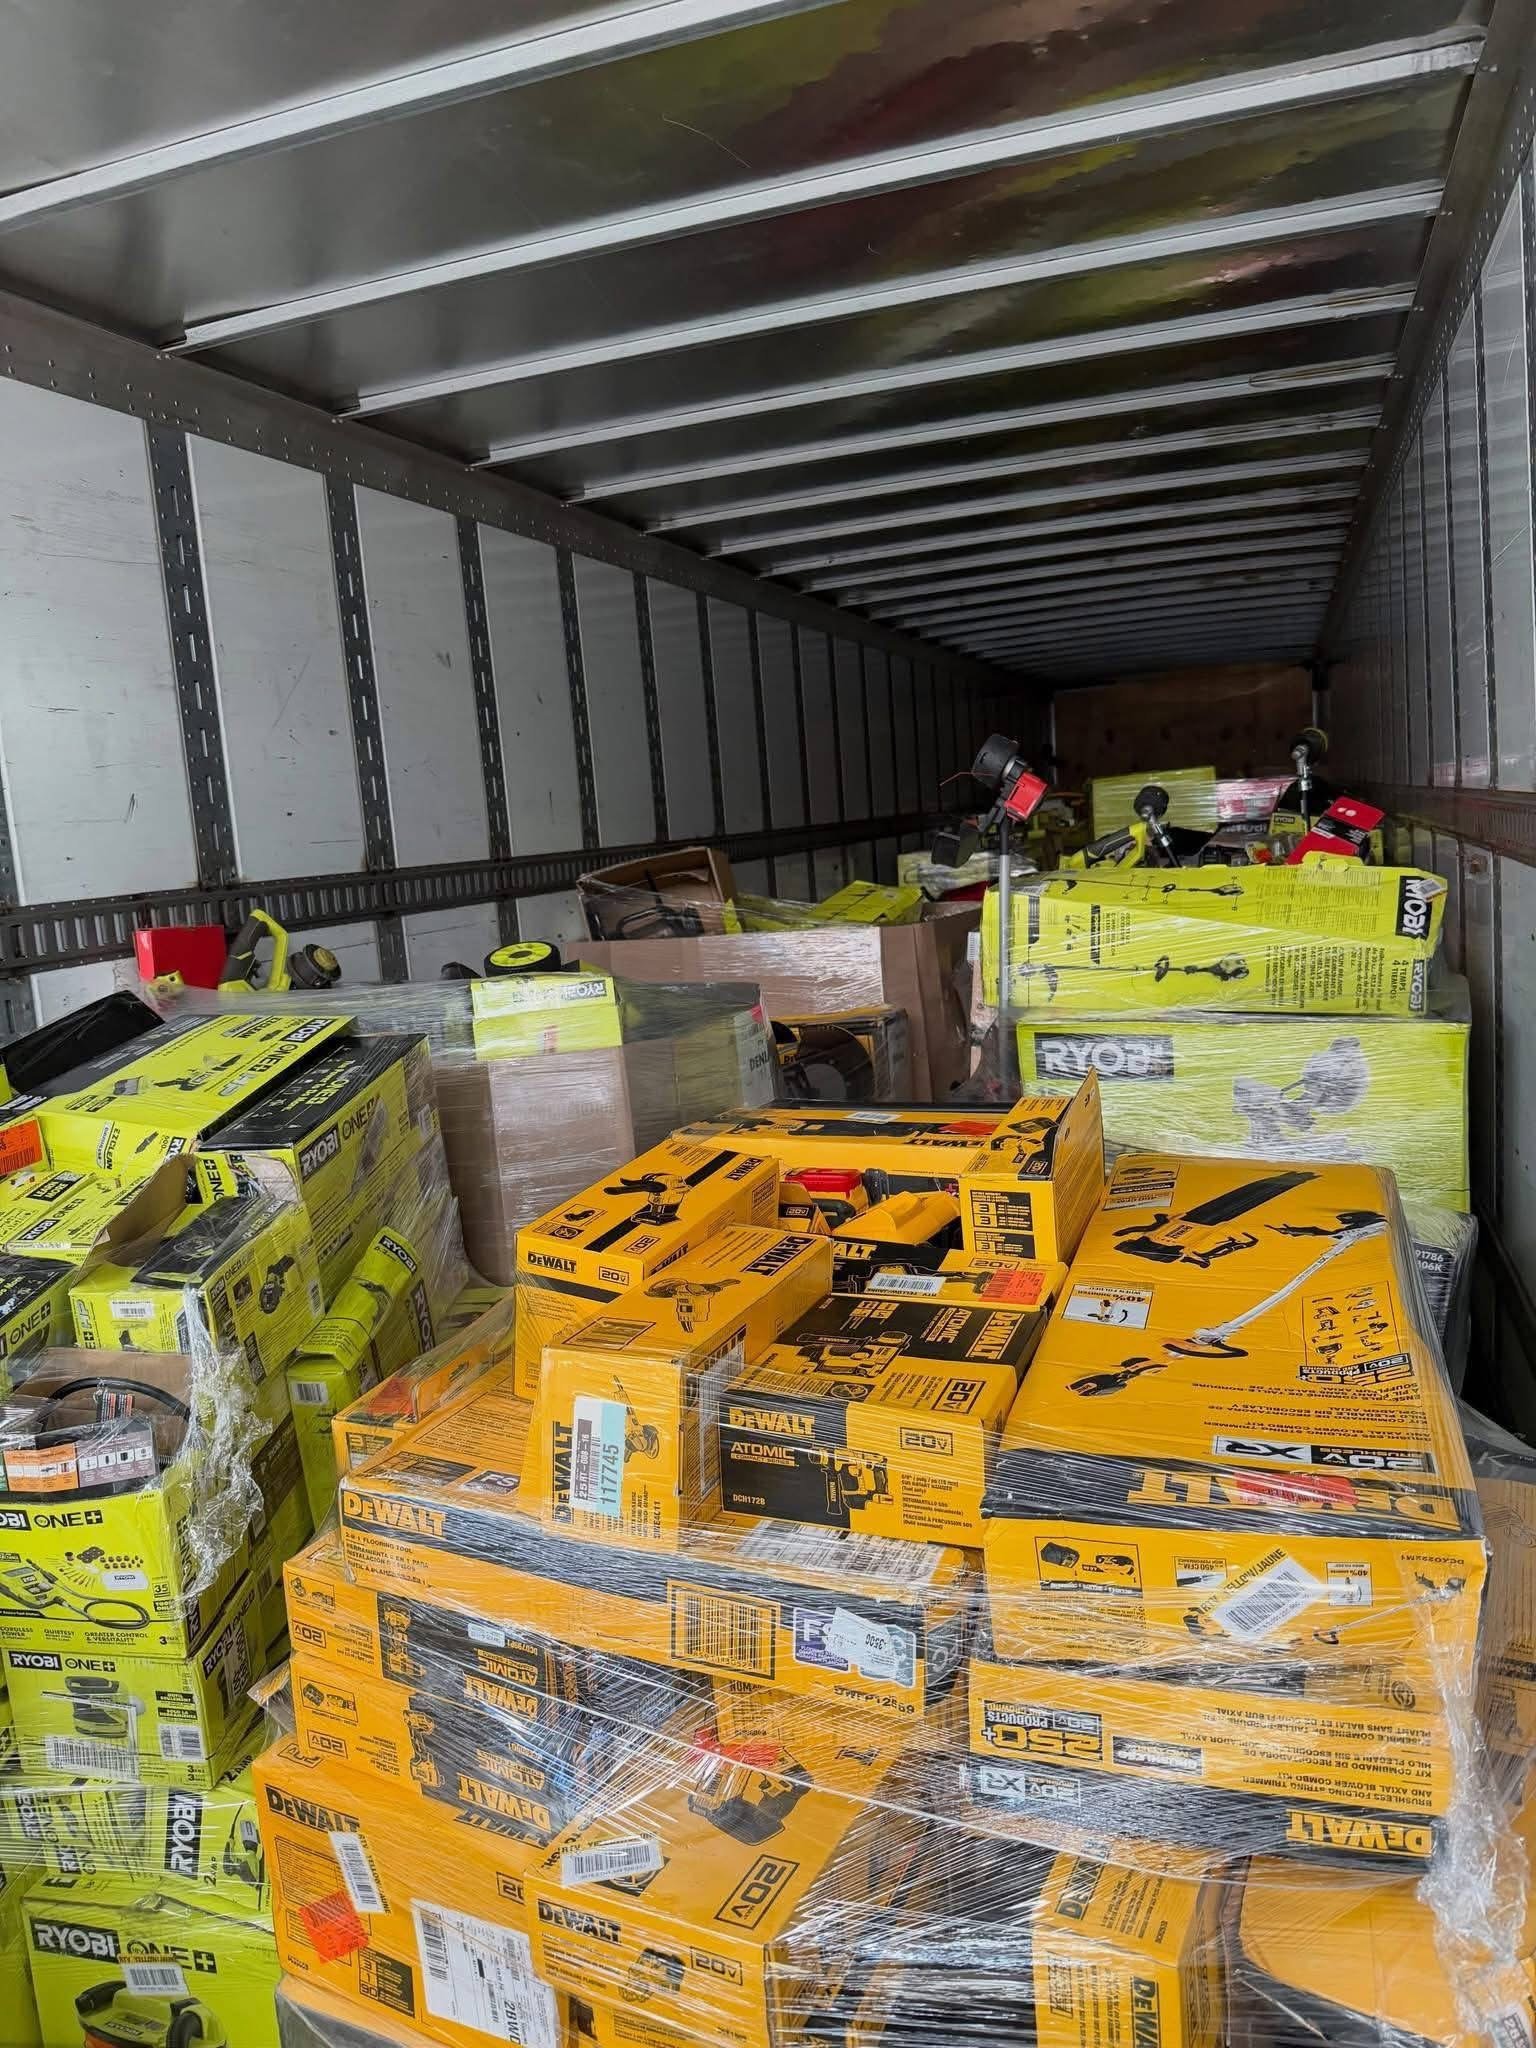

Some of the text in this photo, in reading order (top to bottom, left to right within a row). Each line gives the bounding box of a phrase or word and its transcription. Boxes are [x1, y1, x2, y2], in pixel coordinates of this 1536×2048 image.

[1410, 962, 1423, 1010] RYOBI
[288, 1019, 330, 1042] RYOBI
[1042, 1040, 1162, 1073] RYOBI
[107, 1127, 120, 1170] EZCLEAN
[301, 1127, 338, 1174] RYOBI
[23, 1220, 56, 1240] RYOBI
[382, 1235, 417, 1272] RYOBI
[528, 1253, 576, 1272] DEWALT
[746, 1236, 816, 1276] DEWALT
[974, 1260, 1012, 1269] 20V
[1416, 1250, 1443, 1262] 91786
[601, 1270, 627, 1282] 20V
[10, 1301, 50, 1345] ONE+
[970, 1312, 1022, 1359] DEWALT
[944, 1381, 976, 1408] 20V
[729, 1408, 815, 1435] DEWALT
[730, 1443, 795, 1460] ATOMIC
[904, 1434, 948, 1451] 20V
[1224, 1438, 1306, 1461] XR
[601, 1443, 619, 1504] 117745
[34, 1510, 103, 1528] ONE+
[344, 1491, 445, 1536] DEWALT
[363, 1537, 394, 1550] FLOORING
[154, 1583, 170, 1593] 35
[294, 1625, 323, 1644] 20V
[11, 1653, 116, 1672] RYOBI ONE+
[479, 1656, 538, 1687] ATOMIC
[464, 1675, 538, 1720] DEWALT
[987, 1711, 1048, 1728] PRODUCTS
[311, 1735, 344, 1752] 20V
[981, 1726, 1100, 1761] 250+
[1351, 1762, 1412, 1776] COMBINADO
[1407, 1759, 1431, 1769] HILO
[1415, 1768, 1431, 1778] KIT
[1295, 1774, 1331, 1785] COMBO
[1334, 1779, 1376, 1791] BLOWER
[1379, 1785, 1408, 1795] AXIAL
[458, 1775, 550, 1829] DEWALT
[1328, 1788, 1371, 1800] FOLDING
[1373, 1793, 1432, 1807] BRUSHLESS
[1411, 1788, 1432, 1797] AND
[265, 1786, 360, 1833] DEWALT
[170, 1793, 195, 1874] RYOBI
[1286, 1812, 1430, 1854] DEWALT
[730, 1862, 787, 1919] 20V
[538, 1902, 621, 1943] DEWALT
[34, 1924, 118, 1957] RYOBI
[695, 1952, 738, 1979] 20V
